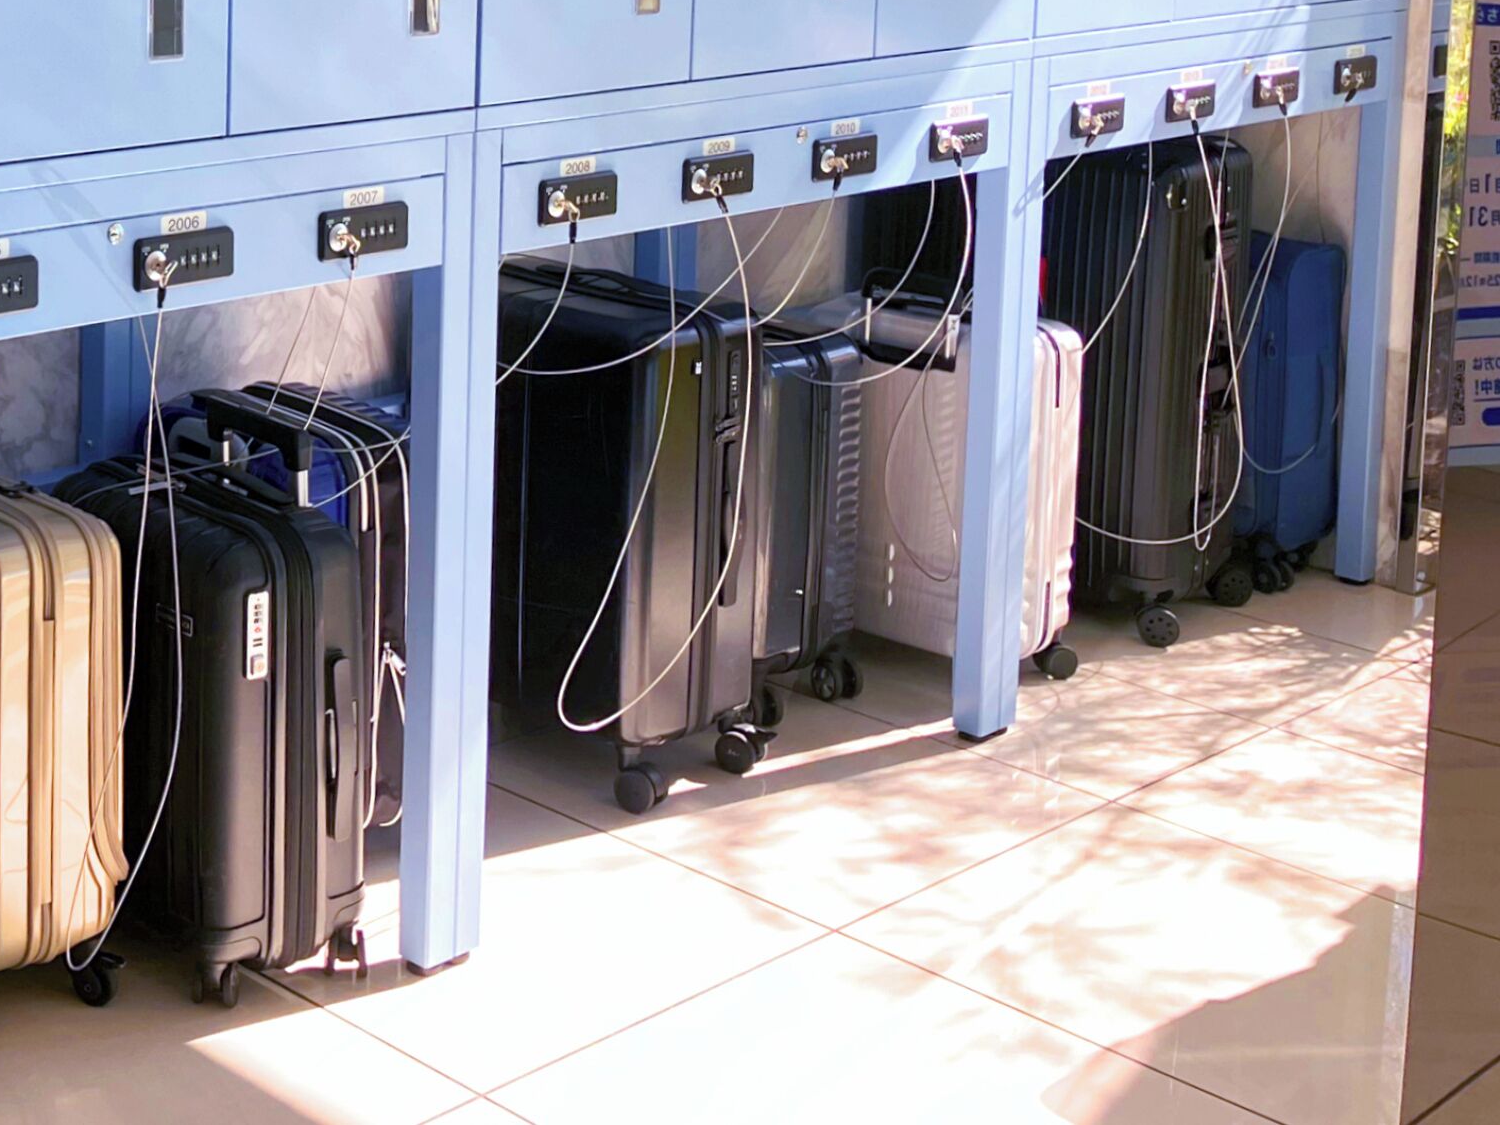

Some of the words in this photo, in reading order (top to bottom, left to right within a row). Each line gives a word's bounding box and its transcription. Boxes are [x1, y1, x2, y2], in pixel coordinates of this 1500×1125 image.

[708, 140, 730, 154] 2009
[565, 160, 590, 175] 2008
[349, 190, 378, 206] 2007
[168, 216, 200, 232] 2006
